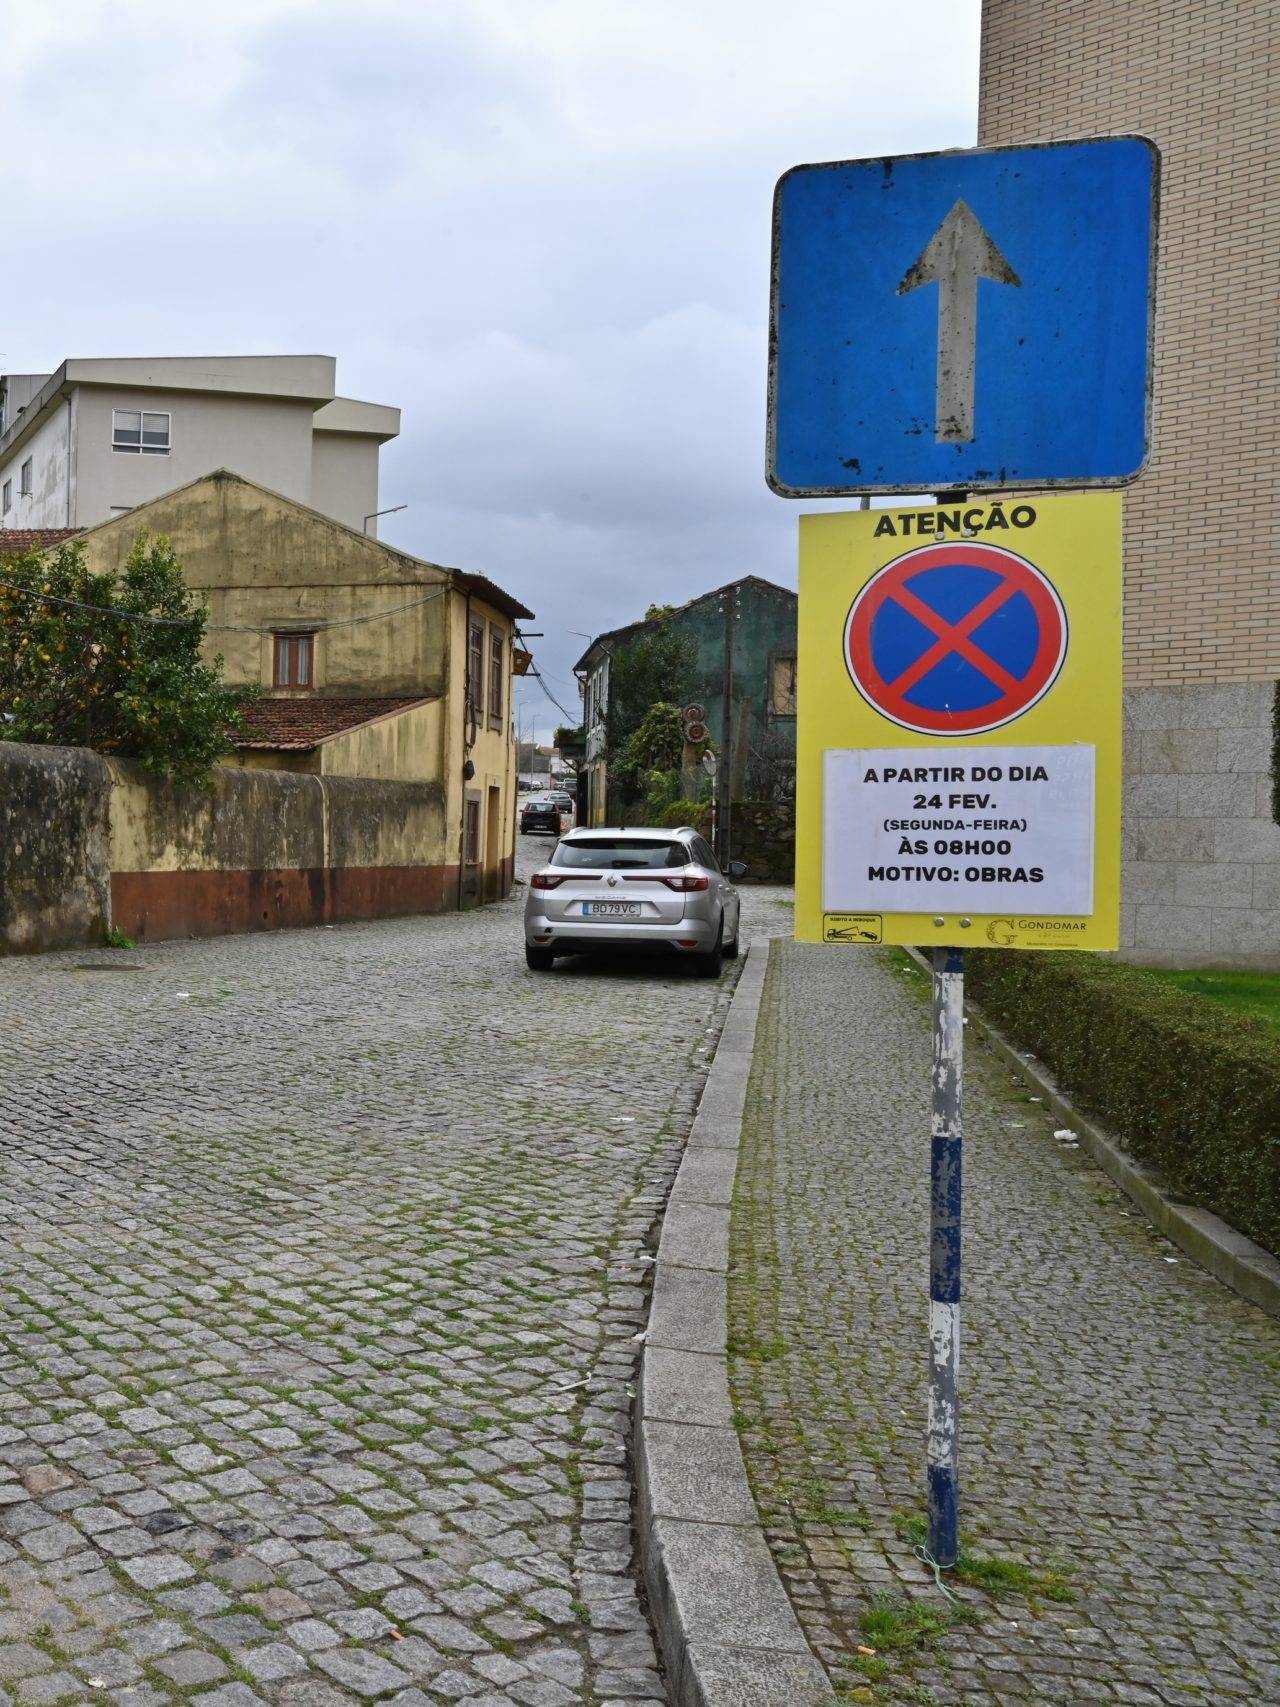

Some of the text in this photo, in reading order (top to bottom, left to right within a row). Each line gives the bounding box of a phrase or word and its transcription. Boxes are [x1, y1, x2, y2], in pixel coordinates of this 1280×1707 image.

[873, 501, 1037, 538] ATENÇÃO
[863, 766, 1049, 783] A PARTIR DO DIA
[913, 793, 997, 809] 24 FEV.
[883, 818, 1027, 832] (SEGUNDA-FEIRA)
[898, 836, 1012, 855] ÀS 08H00
[868, 866, 1044, 883] MOTIVO: OBRAS
[1018, 919, 1087, 930] GONDOMAR
